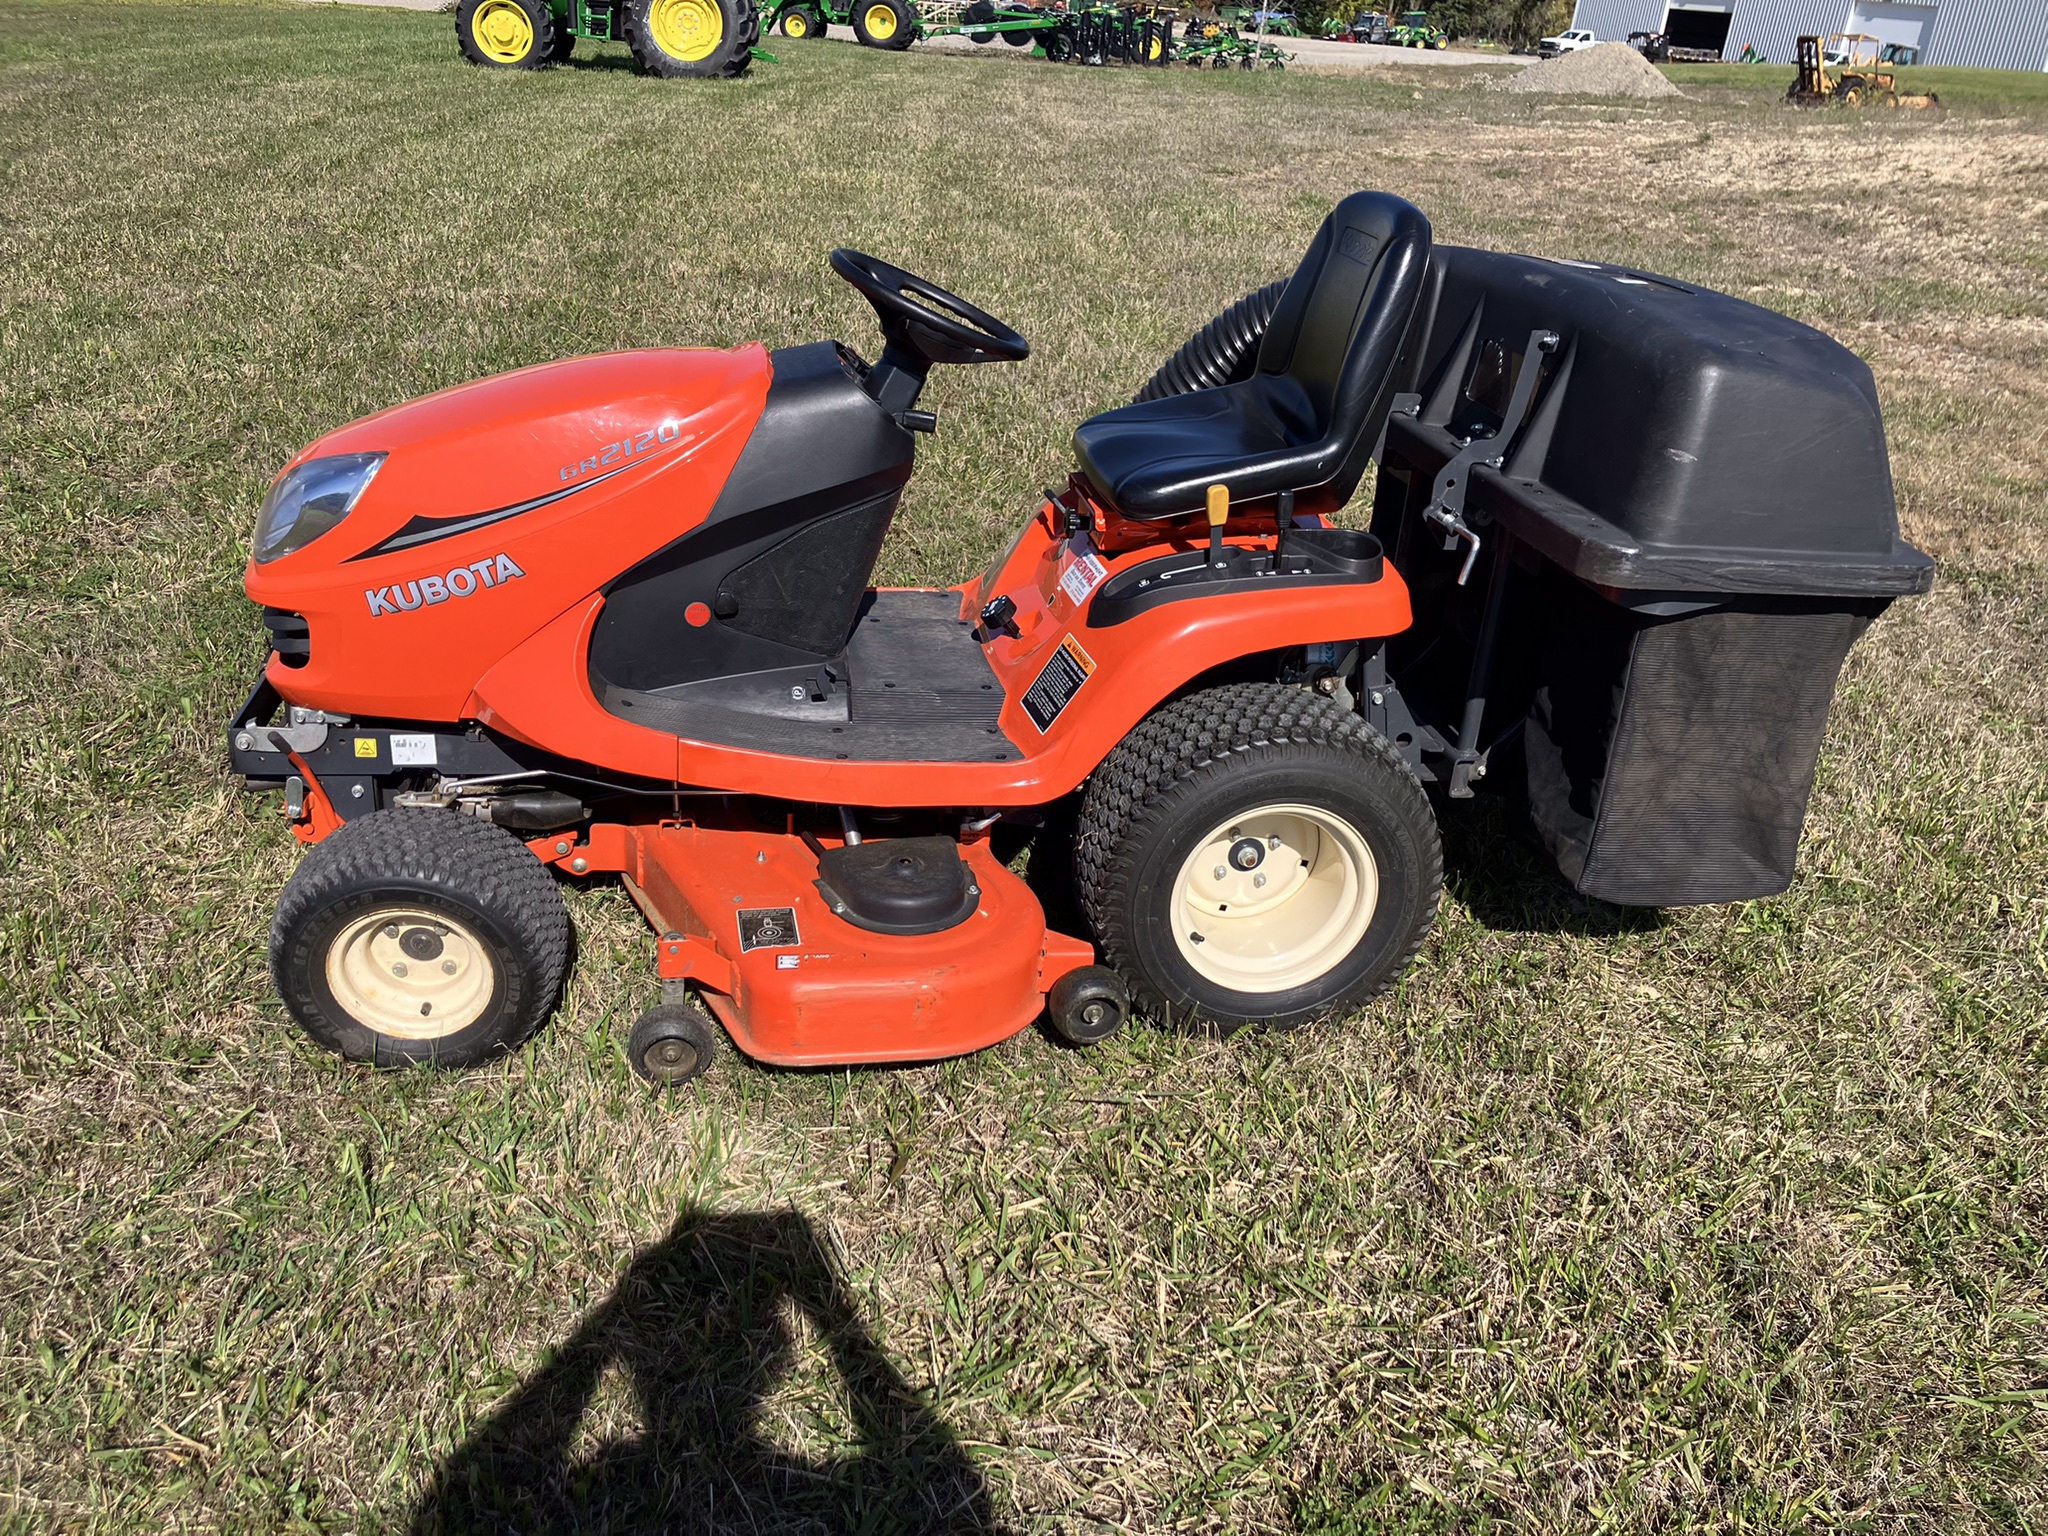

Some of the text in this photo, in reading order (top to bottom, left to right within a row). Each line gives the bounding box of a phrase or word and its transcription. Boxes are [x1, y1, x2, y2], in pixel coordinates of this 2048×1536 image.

[560, 417, 680, 481] GR2120
[364, 552, 527, 617] KUBOTA
[1072, 557, 1098, 588] RENTAL
[1071, 645, 1090, 670] WARNING
[499, 946, 521, 1014] KENDA
